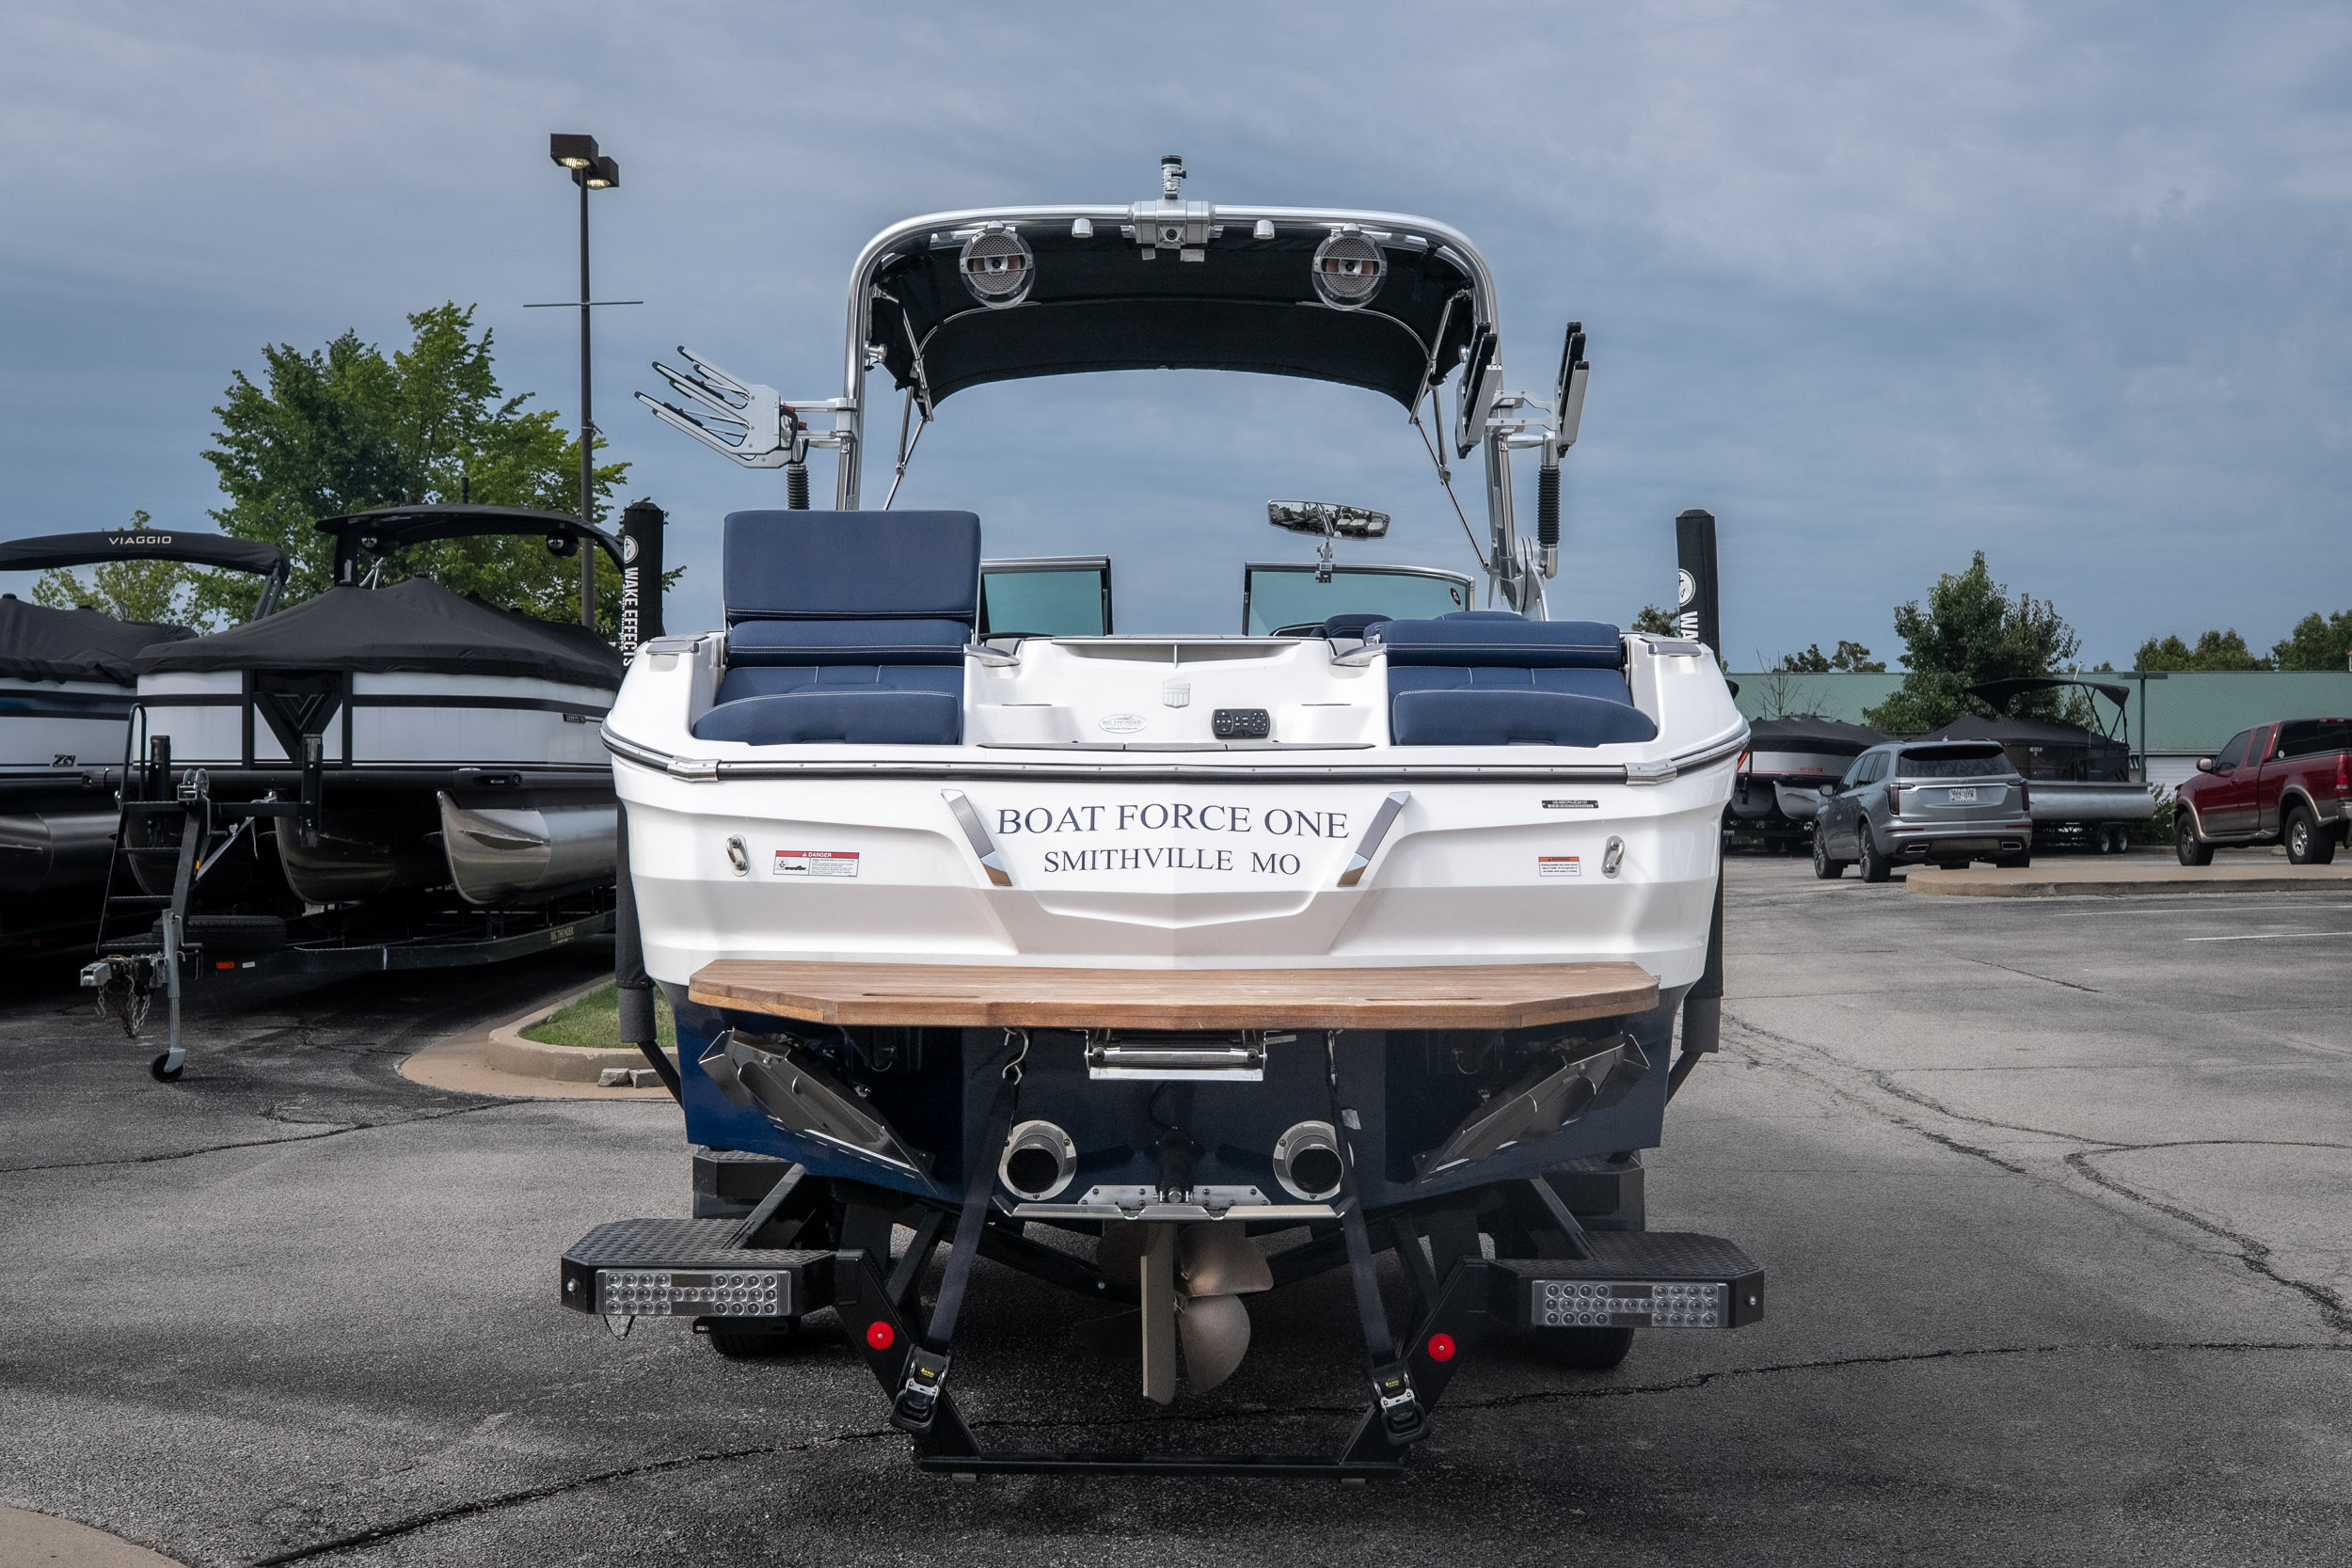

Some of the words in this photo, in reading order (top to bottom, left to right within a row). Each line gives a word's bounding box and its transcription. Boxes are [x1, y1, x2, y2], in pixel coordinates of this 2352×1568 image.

[108, 535, 172, 545] VIAGGIO
[624, 566, 638, 607] WAKE
[623, 610, 639, 667] EFFECTS
[995, 805, 1105, 835] BOAT
[1116, 802, 1252, 832] FORCE
[1263, 808, 1350, 839] ONE
[1043, 847, 1234, 874] SMITHVILLE
[1250, 850, 1301, 876] MO
